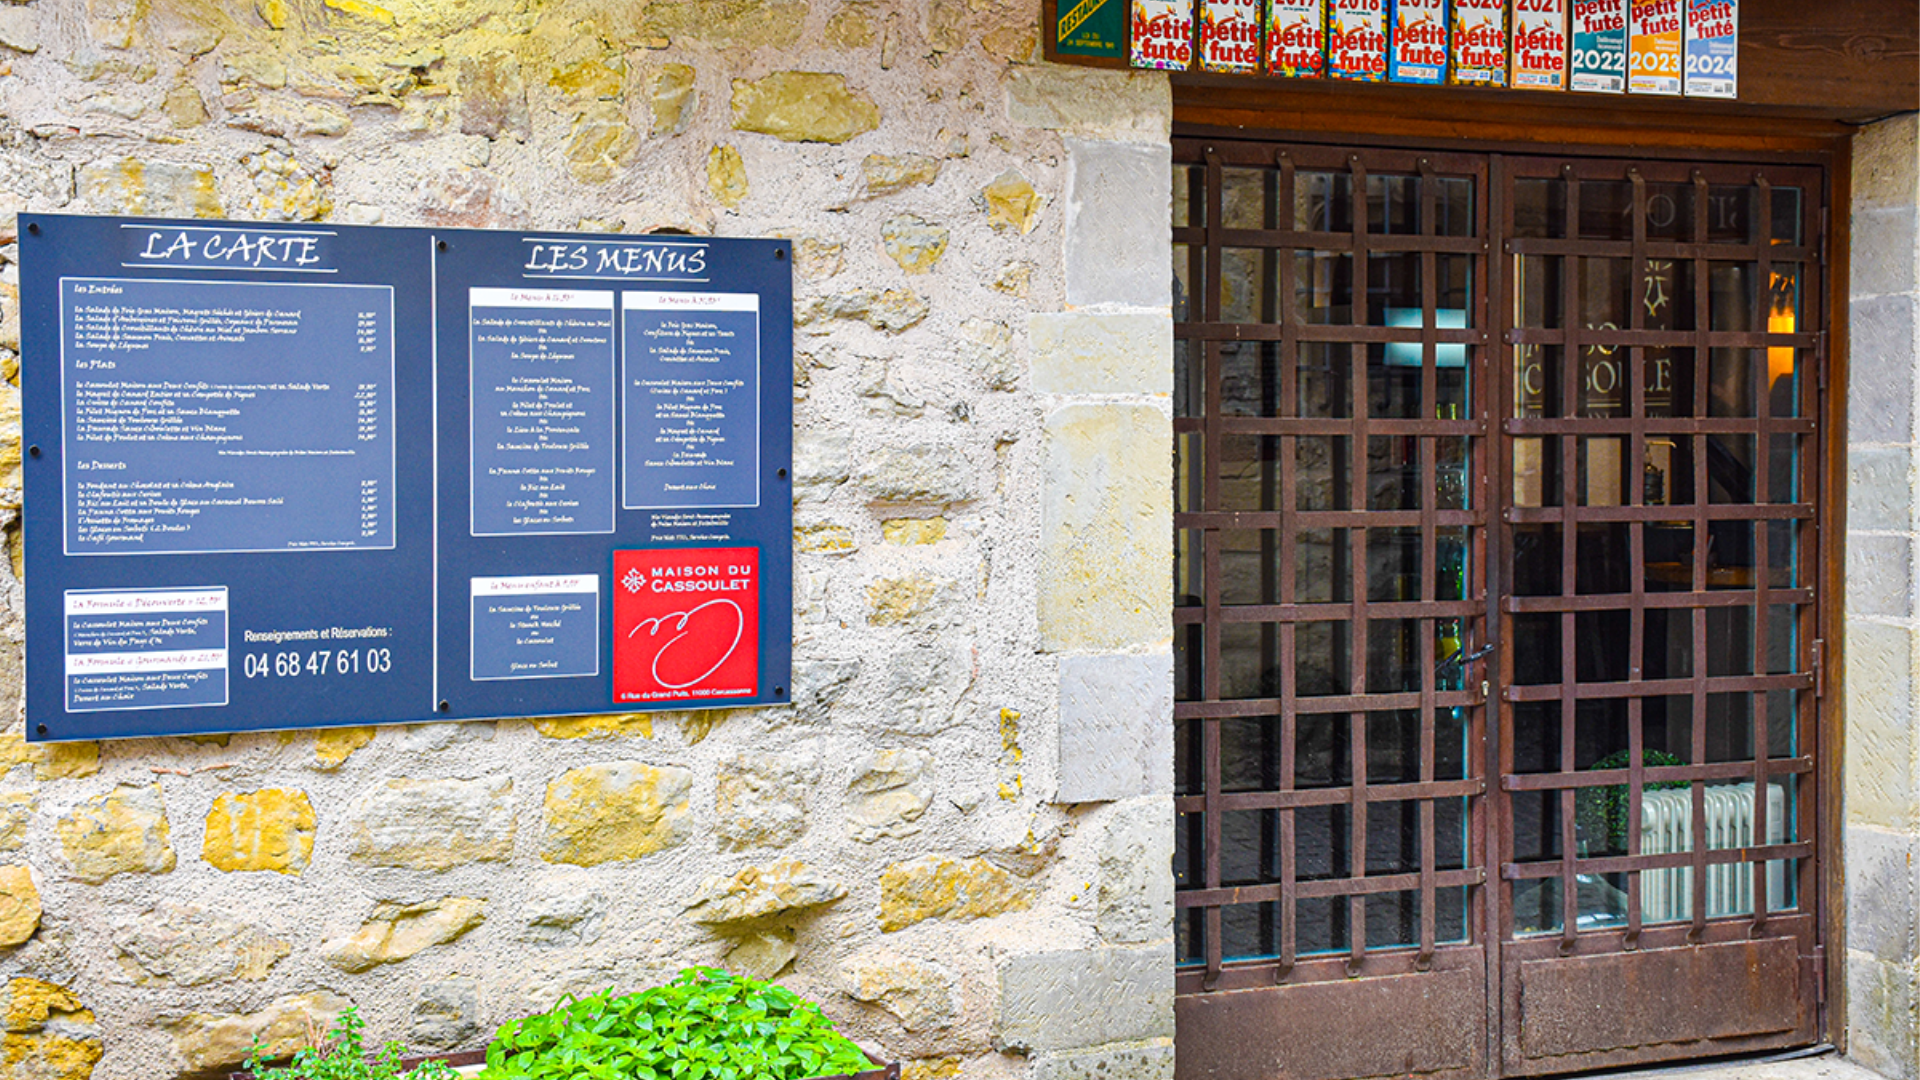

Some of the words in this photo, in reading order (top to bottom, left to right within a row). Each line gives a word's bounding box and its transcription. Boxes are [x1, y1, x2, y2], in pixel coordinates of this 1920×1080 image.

[1516, 0, 1562, 12] 2021
[1574, 0, 1621, 20] petit
[1631, 0, 1677, 23] petit
[1688, 3, 1731, 27] petit
[1134, 19, 1191, 41] petit
[1201, 22, 1258, 44] petit
[1584, 13, 1624, 33] futé
[1641, 17, 1679, 36] futé
[1697, 20, 1734, 39] futé
[1266, 28, 1323, 50] petit
[1332, 32, 1385, 53] petit
[1393, 25, 1446, 47] petit
[1454, 28, 1504, 50] petit
[1514, 31, 1564, 53] petit
[1142, 39, 1190, 61] futé
[1210, 40, 1258, 63] futé
[1276, 47, 1323, 69] futé
[1573, 49, 1624, 69] 2022
[1339, 51, 1384, 72] futé
[1631, 52, 1680, 72] 2023
[1687, 55, 1734, 74] 2024
[140, 232, 197, 260] LA
[203, 234, 321, 266] CARTE
[524, 246, 589, 272] LES
[596, 248, 707, 274] MENUS
[89, 284, 123, 294] Entrées
[89, 360, 116, 370] Plats
[85, 381, 119, 389] Cassoulet
[91, 461, 126, 471] Desserts
[106, 534, 144, 544] Gourmand
[652, 566, 719, 577] MAISON
[728, 565, 751, 575] DU
[651, 579, 750, 592] CASSOULET
[87, 599, 124, 609] Formule
[103, 638, 116, 646] Vin
[244, 629, 318, 644] Renseignements
[320, 629, 329, 639] et
[331, 626, 387, 639] Réservations
[87, 656, 124, 666] Formule
[244, 653, 269, 678] 04
[275, 652, 300, 676] 68
[306, 651, 331, 675] 47
[337, 649, 359, 674] 61
[367, 648, 391, 673] 03
